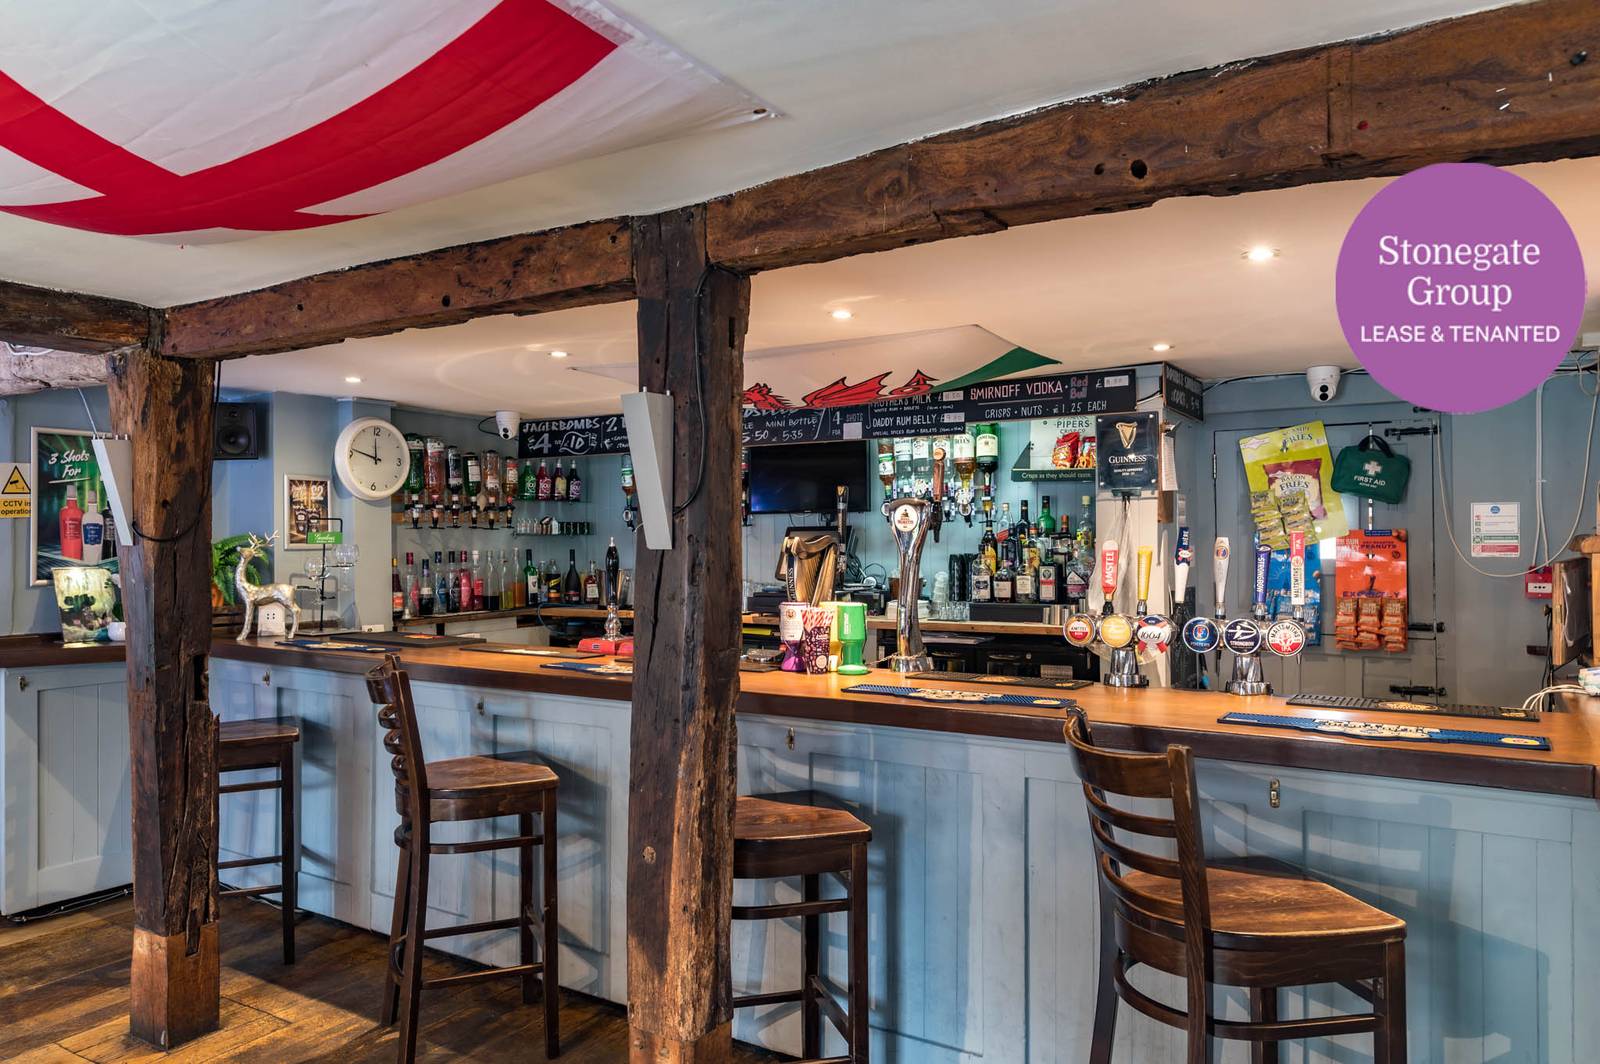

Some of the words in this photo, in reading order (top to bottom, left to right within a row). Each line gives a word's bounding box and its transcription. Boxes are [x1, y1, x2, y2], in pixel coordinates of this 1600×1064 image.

[970, 384, 1021, 400] SMIRNOFF
[1026, 380, 1063, 396] VODKA
[1070, 375, 1089, 388] Red
[912, 393, 931, 405] MILK
[985, 407, 1011, 419] CRISPS
[1021, 404, 1043, 417] NUTS
[1087, 400, 1107, 412] EACH
[522, 418, 600, 433] JAGERBOMBS
[606, 416, 617, 432] 2
[765, 419, 786, 428] MINI
[789, 416, 819, 427] BOTTLE
[872, 418, 894, 428] DADDY
[896, 416, 911, 426] RUM
[912, 414, 937, 425] BELLY
[1056, 419, 1090, 429] PIPERS
[374, 427, 381, 436] 12
[48, 453, 59, 464] 3
[60, 449, 90, 463] Shots
[396, 458, 402, 467] 3
[1109, 455, 1147, 464] GUINNESS
[62, 465, 81, 478] For
[1022, 472, 1038, 480] Crisps
[1045, 472, 1058, 480] they
[1280, 480, 1311, 491] FRIES
[1354, 475, 1372, 484] FIRST
[370, 482, 377, 491] 6
[1105, 551, 1115, 585] AMSTEL
[1256, 554, 1266, 592] STRONGBOW
